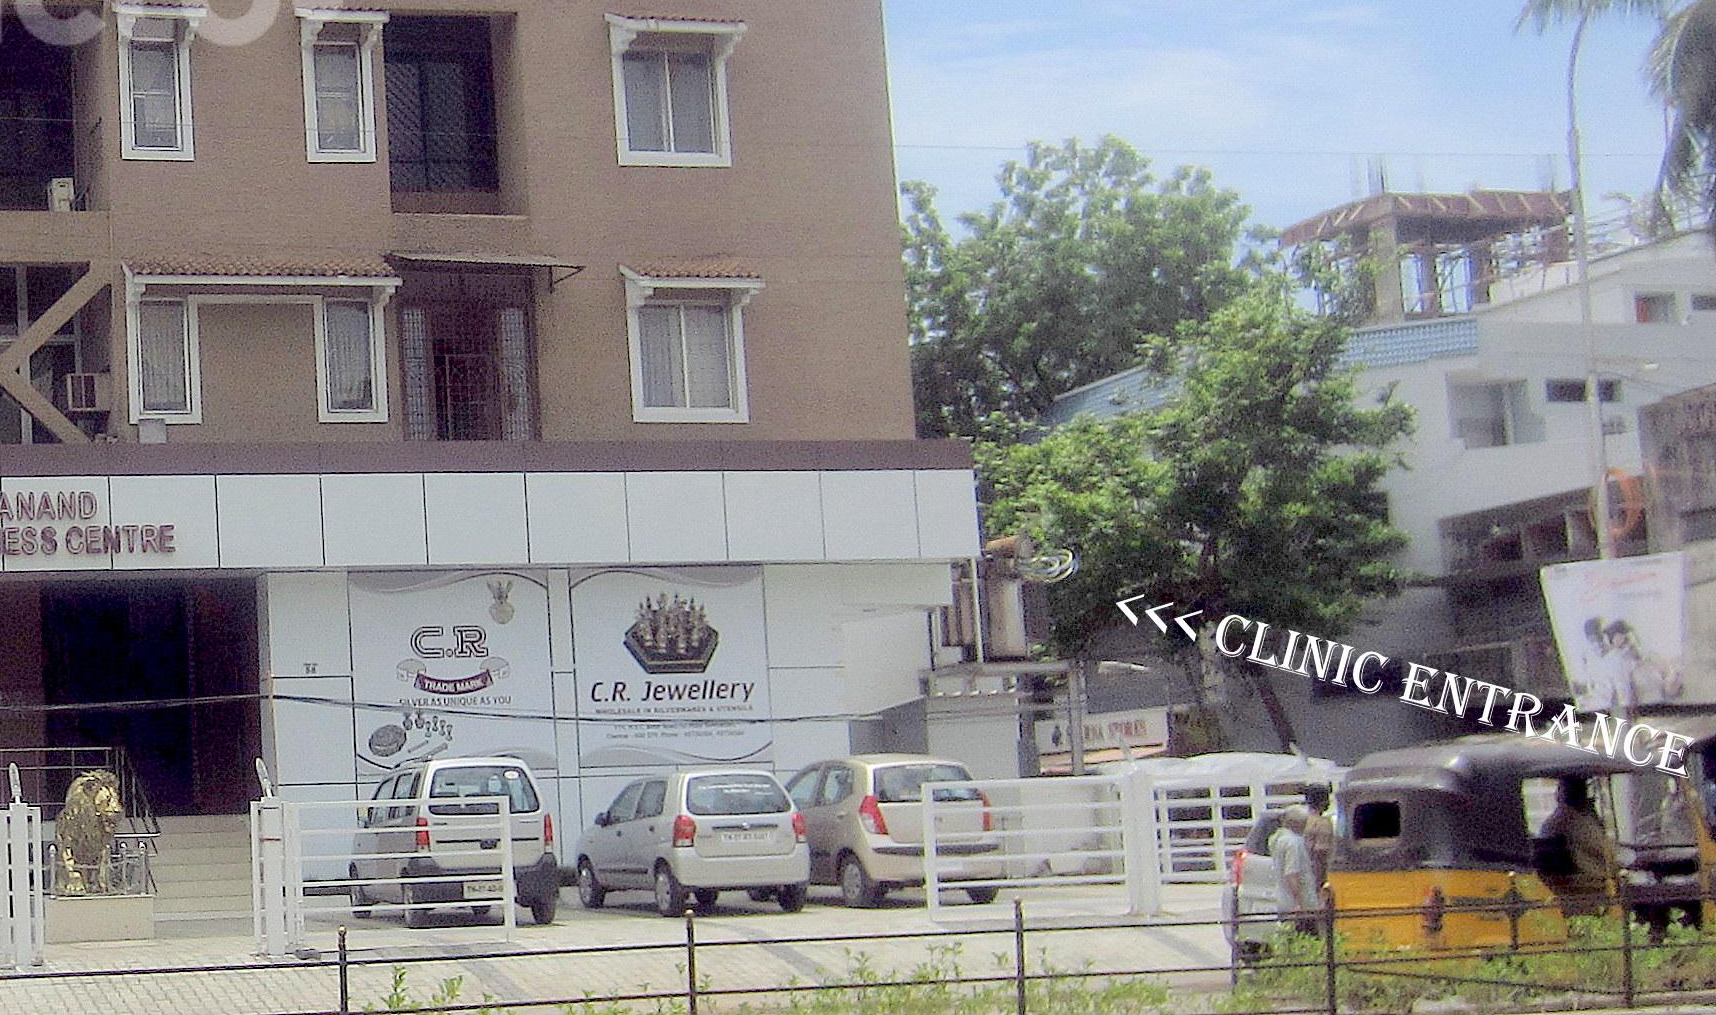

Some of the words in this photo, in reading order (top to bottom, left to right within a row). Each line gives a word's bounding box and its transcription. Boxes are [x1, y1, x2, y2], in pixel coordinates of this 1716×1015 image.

[64, 524, 177, 555] CENTRE
[410, 625, 489, 659] C.R
[444, 696, 478, 706] UNIQUE
[481, 695, 491, 704] AS
[493, 695, 512, 704] YOU
[590, 681, 631, 703] C.R.
[641, 679, 755, 703] Jewellery
